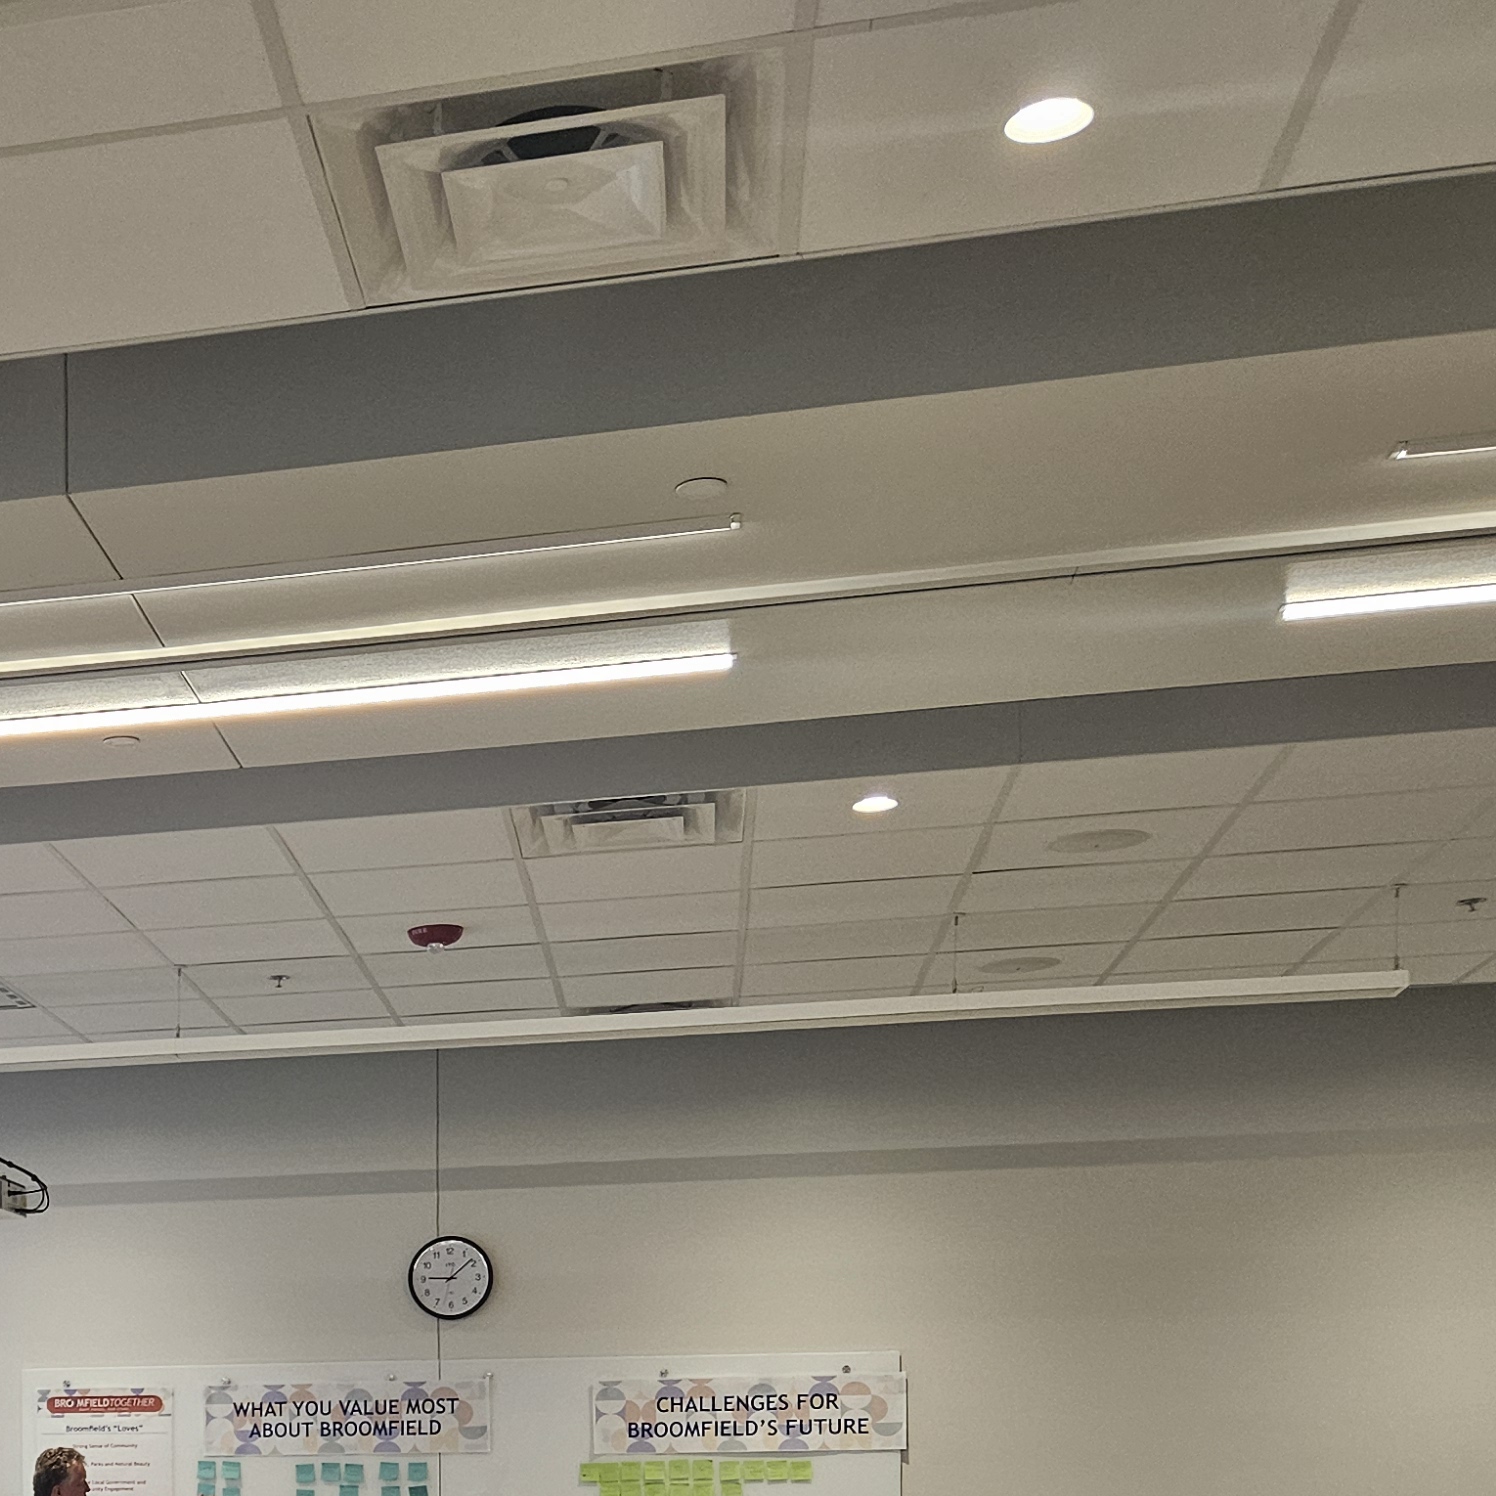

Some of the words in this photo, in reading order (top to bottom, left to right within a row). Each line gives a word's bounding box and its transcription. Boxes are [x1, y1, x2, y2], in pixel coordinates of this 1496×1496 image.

[233, 1401, 281, 1418] WHAT
[292, 1400, 332, 1417] YOU
[340, 1398, 399, 1416] VALUE
[406, 1397, 460, 1415] MOST
[656, 1394, 789, 1413] CHALLENGES
[797, 1392, 839, 1411] FOR
[249, 1422, 313, 1439] ABOUT
[320, 1419, 442, 1437] BROOMFIELD
[628, 1419, 778, 1438] BROOMFIELD'S
[786, 1417, 869, 1436] FUTURE
